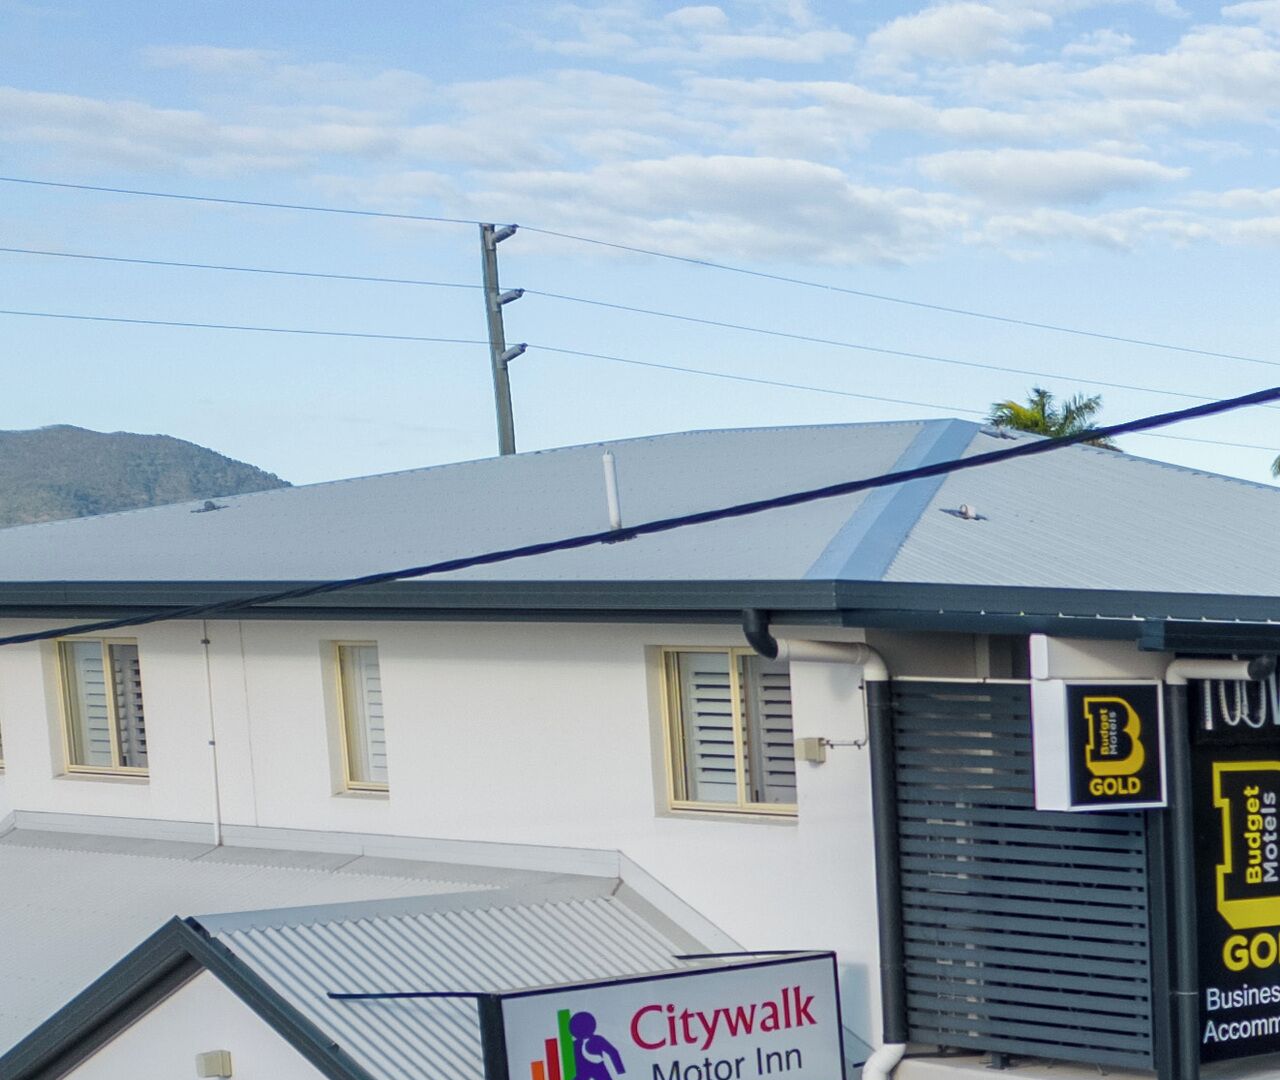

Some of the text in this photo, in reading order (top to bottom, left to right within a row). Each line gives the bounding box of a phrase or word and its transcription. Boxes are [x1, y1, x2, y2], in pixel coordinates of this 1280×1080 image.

[1100, 708, 1109, 755] Budget
[1109, 711, 1118, 755] Motels
[1089, 777, 1141, 796] GOLD
[1243, 785, 1263, 884] Budget
[1263, 791, 1278, 883] Motels
[630, 986, 818, 1050] Citywalk
[756, 1047, 803, 1076] Inn
